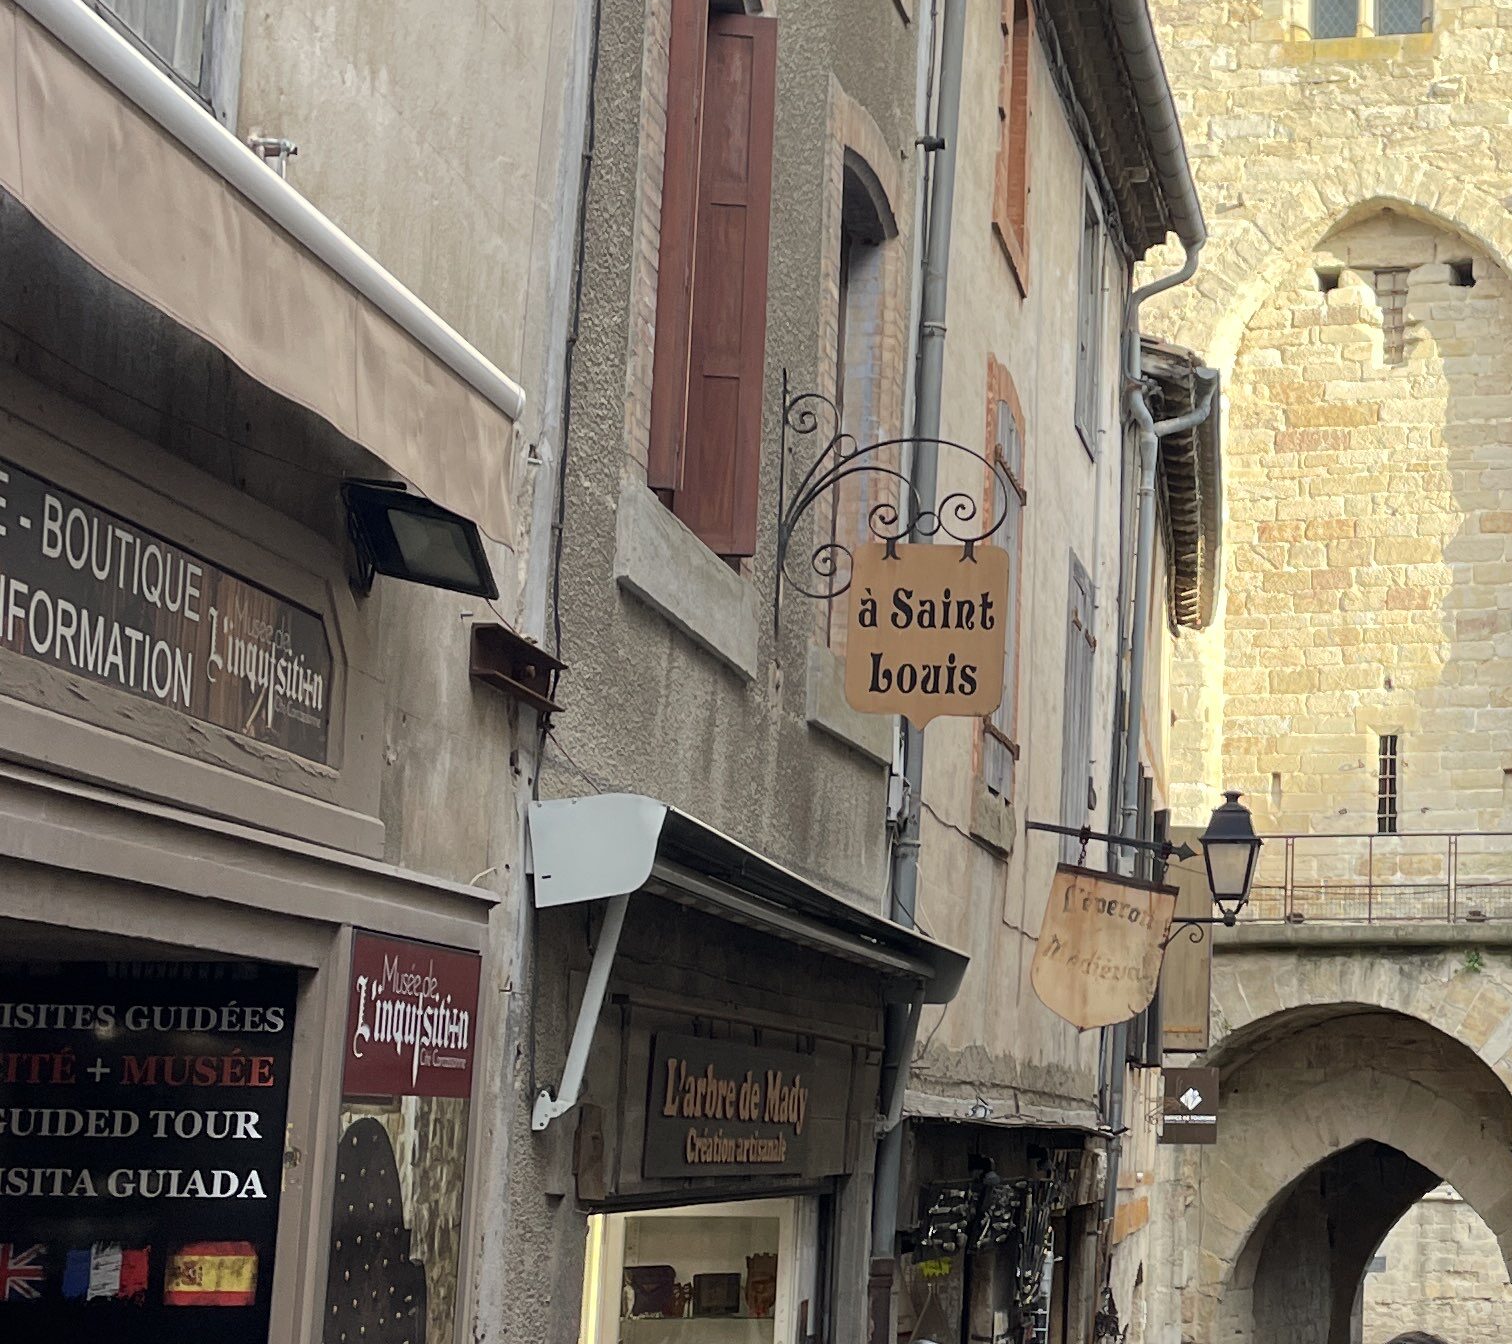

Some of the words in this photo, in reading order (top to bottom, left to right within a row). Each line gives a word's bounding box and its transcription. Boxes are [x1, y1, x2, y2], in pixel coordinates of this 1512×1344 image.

[42, 494, 203, 623] BOUTIQUE
[858, 587, 878, 628] à
[890, 587, 995, 631] Saint
[868, 652, 977, 696] Louis
[0, 1003, 116, 1034] ISITES
[125, 1000, 285, 1033] GUIDÉES
[0, 1045, 77, 1085] ITÉ
[119, 1047, 275, 1087] MUSÉE
[663, 1057, 736, 1119] L'arbre
[738, 1070, 761, 1122] de
[764, 1069, 809, 1136] Mady
[0, 1108, 140, 1138] UIDED
[150, 1110, 263, 1139] TOUR
[107, 1168, 268, 1199] GUIADA
